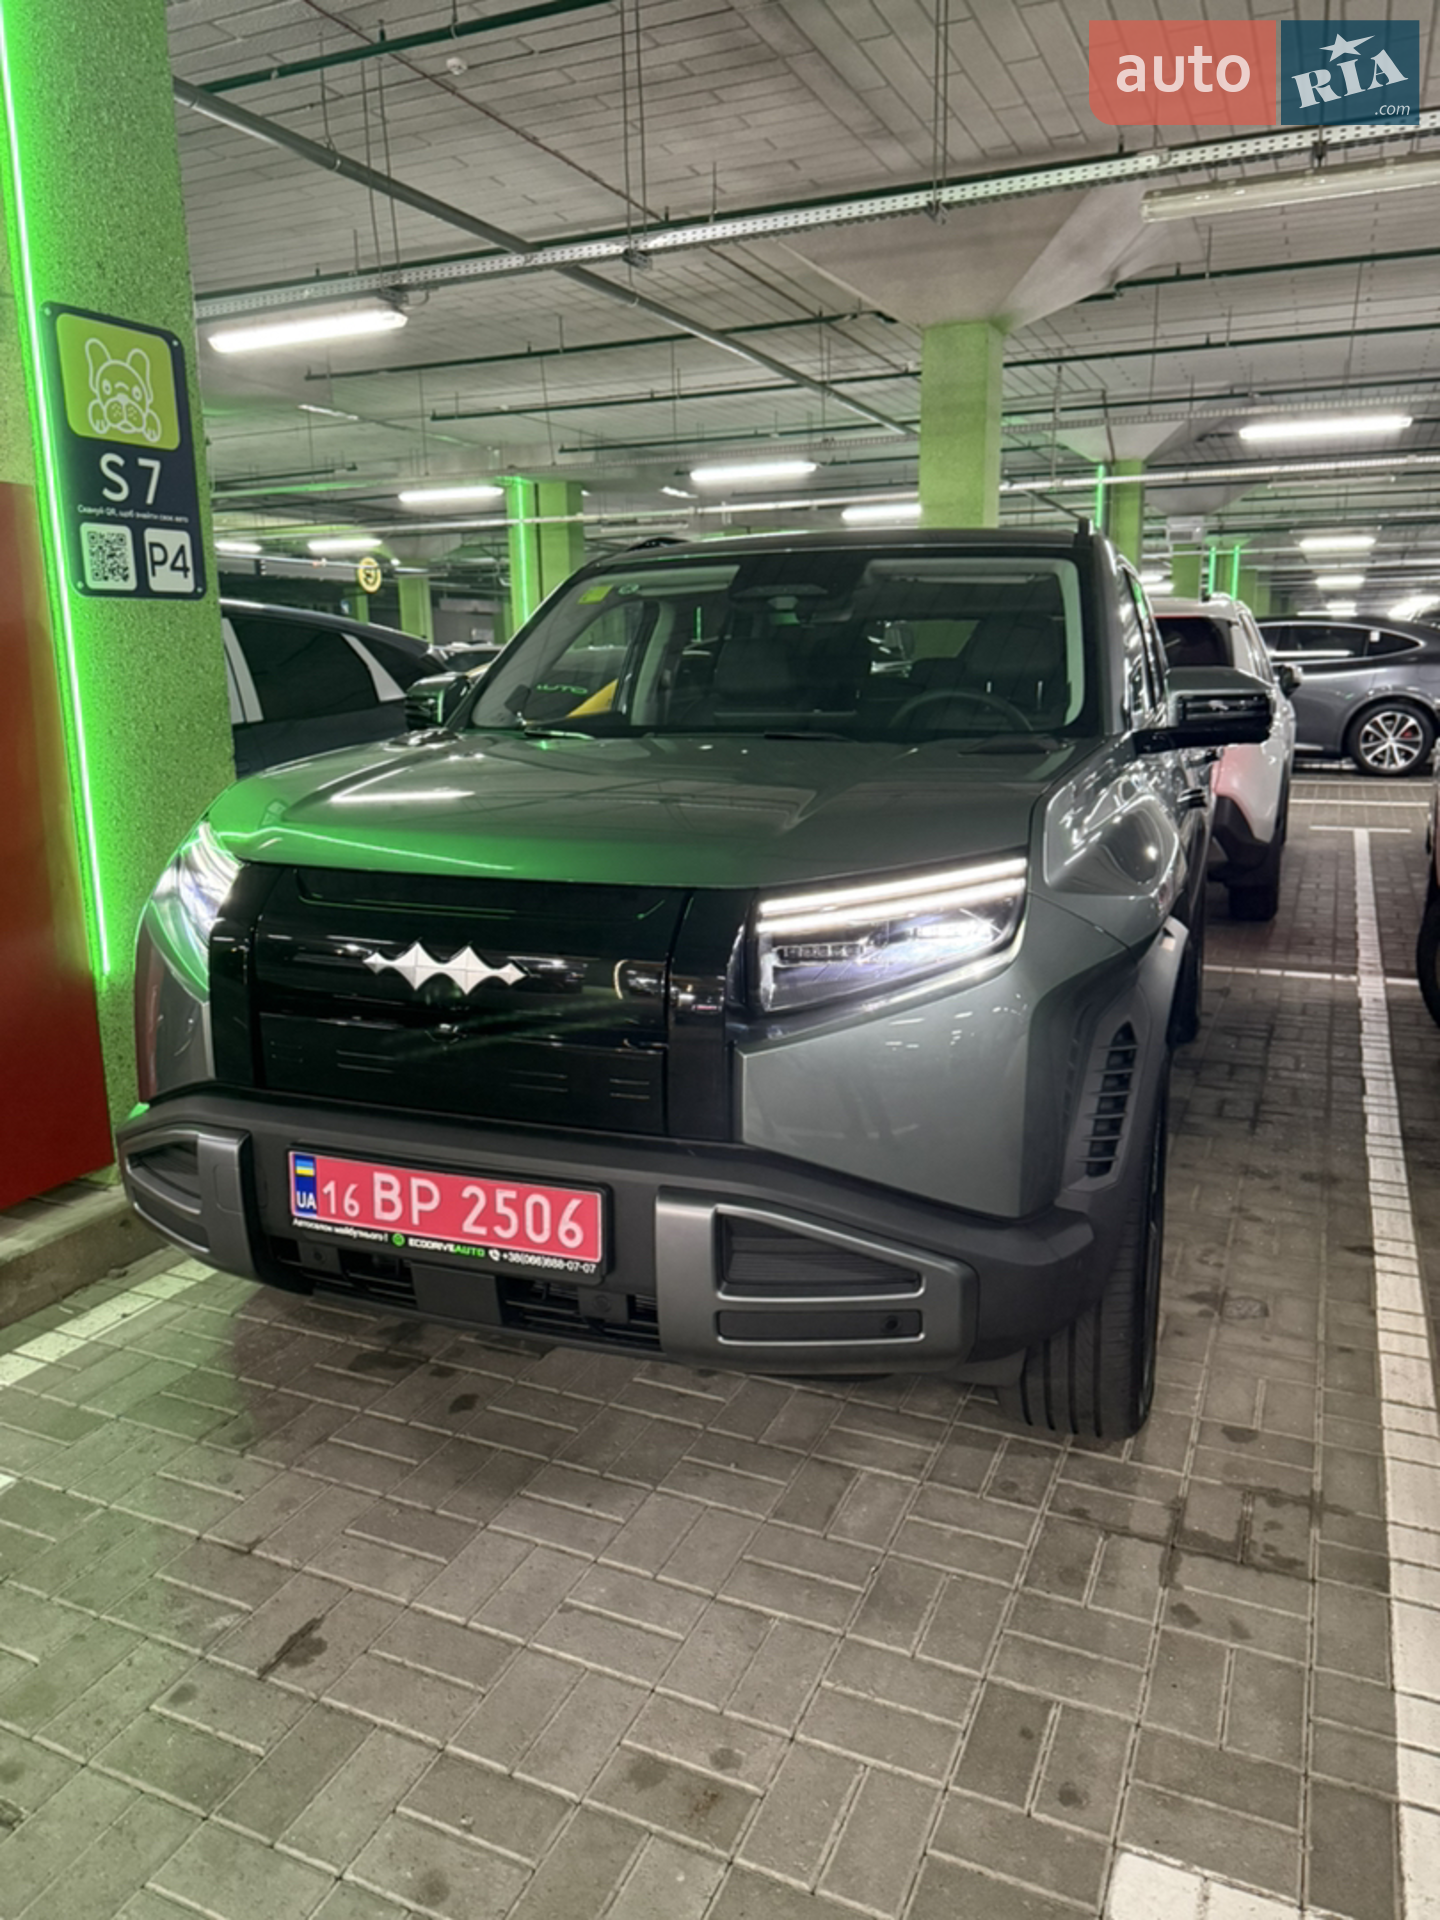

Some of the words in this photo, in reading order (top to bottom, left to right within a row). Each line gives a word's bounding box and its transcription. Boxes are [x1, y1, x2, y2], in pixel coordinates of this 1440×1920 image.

[148, 541, 190, 579] P4
[295, 1190, 317, 1210] UA
[322, 1180, 360, 1218] 16
[461, 1185, 584, 1249] 2506
